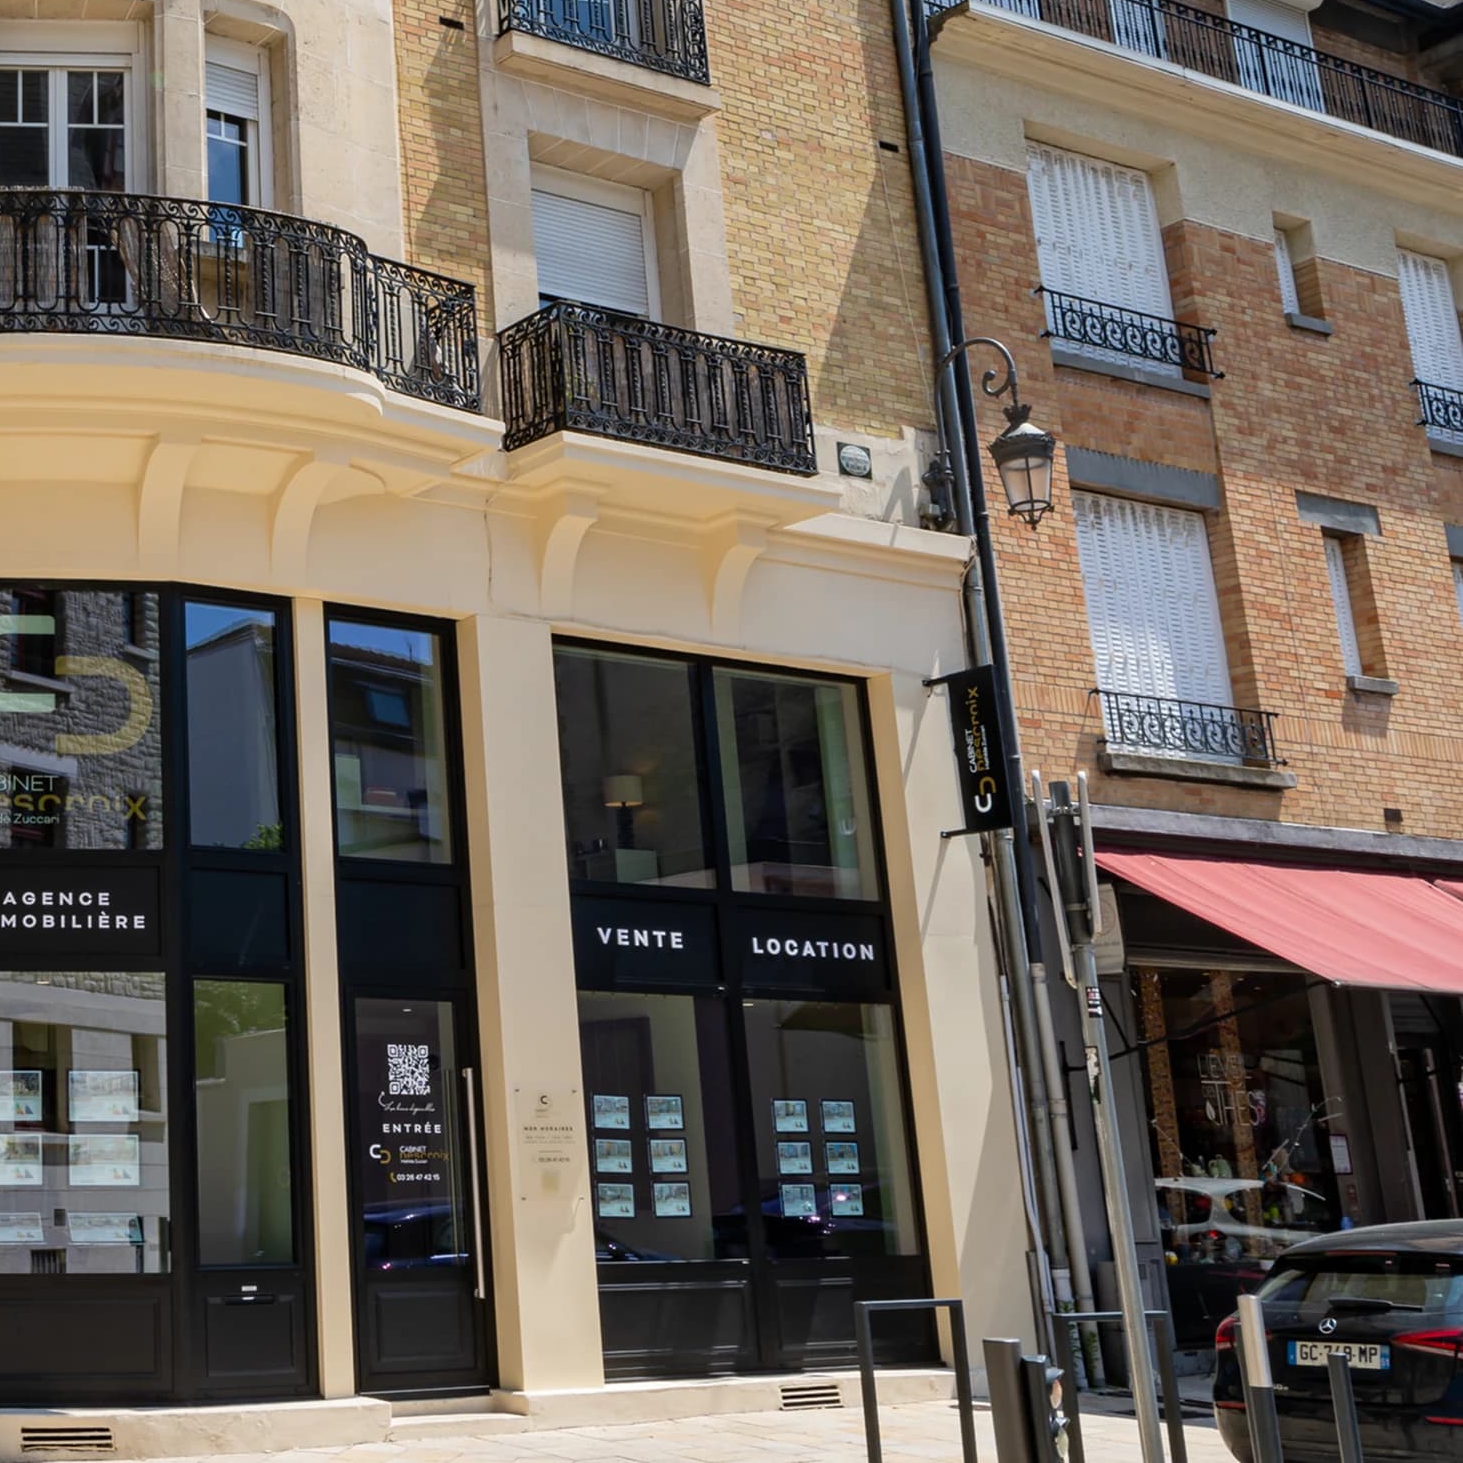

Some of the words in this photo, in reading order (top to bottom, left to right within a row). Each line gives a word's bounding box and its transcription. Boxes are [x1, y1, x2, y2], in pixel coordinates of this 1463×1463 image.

[965, 728, 978, 773] CABINET
[2, 891, 110, 906] AGENCE
[597, 927, 685, 949] VENTE
[752, 937, 875, 961] LOCATION
[382, 1121, 442, 1134] ENTRÉE
